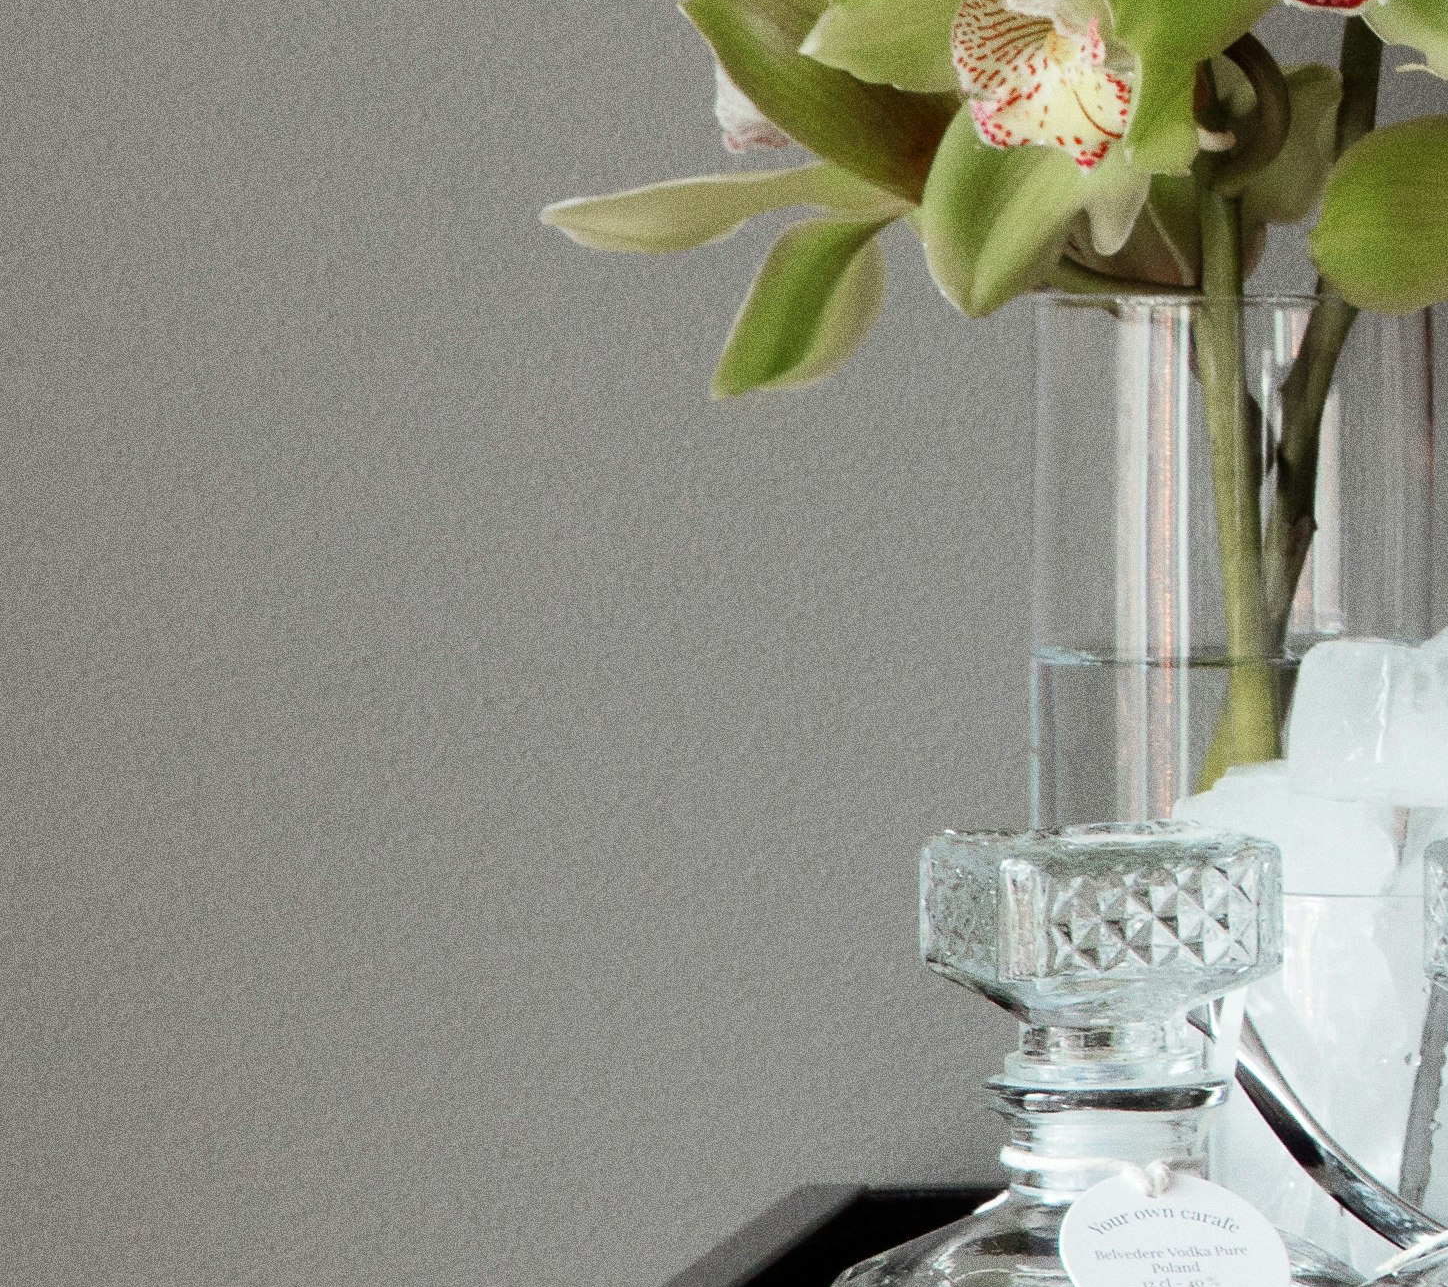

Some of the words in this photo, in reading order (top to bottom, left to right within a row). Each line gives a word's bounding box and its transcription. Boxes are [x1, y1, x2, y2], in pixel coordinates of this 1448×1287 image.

[1088, 1211, 1128, 1236] Your
[1134, 1207, 1174, 1221] own
[1180, 1208, 1240, 1234] carafe
[1095, 1248, 1164, 1261] Belvedere
[1167, 1247, 1212, 1259] Vodka
[1214, 1245, 1248, 1257] Pure
[1152, 1261, 1201, 1274] Poland
[1207, 1276, 1221, 1287] %
